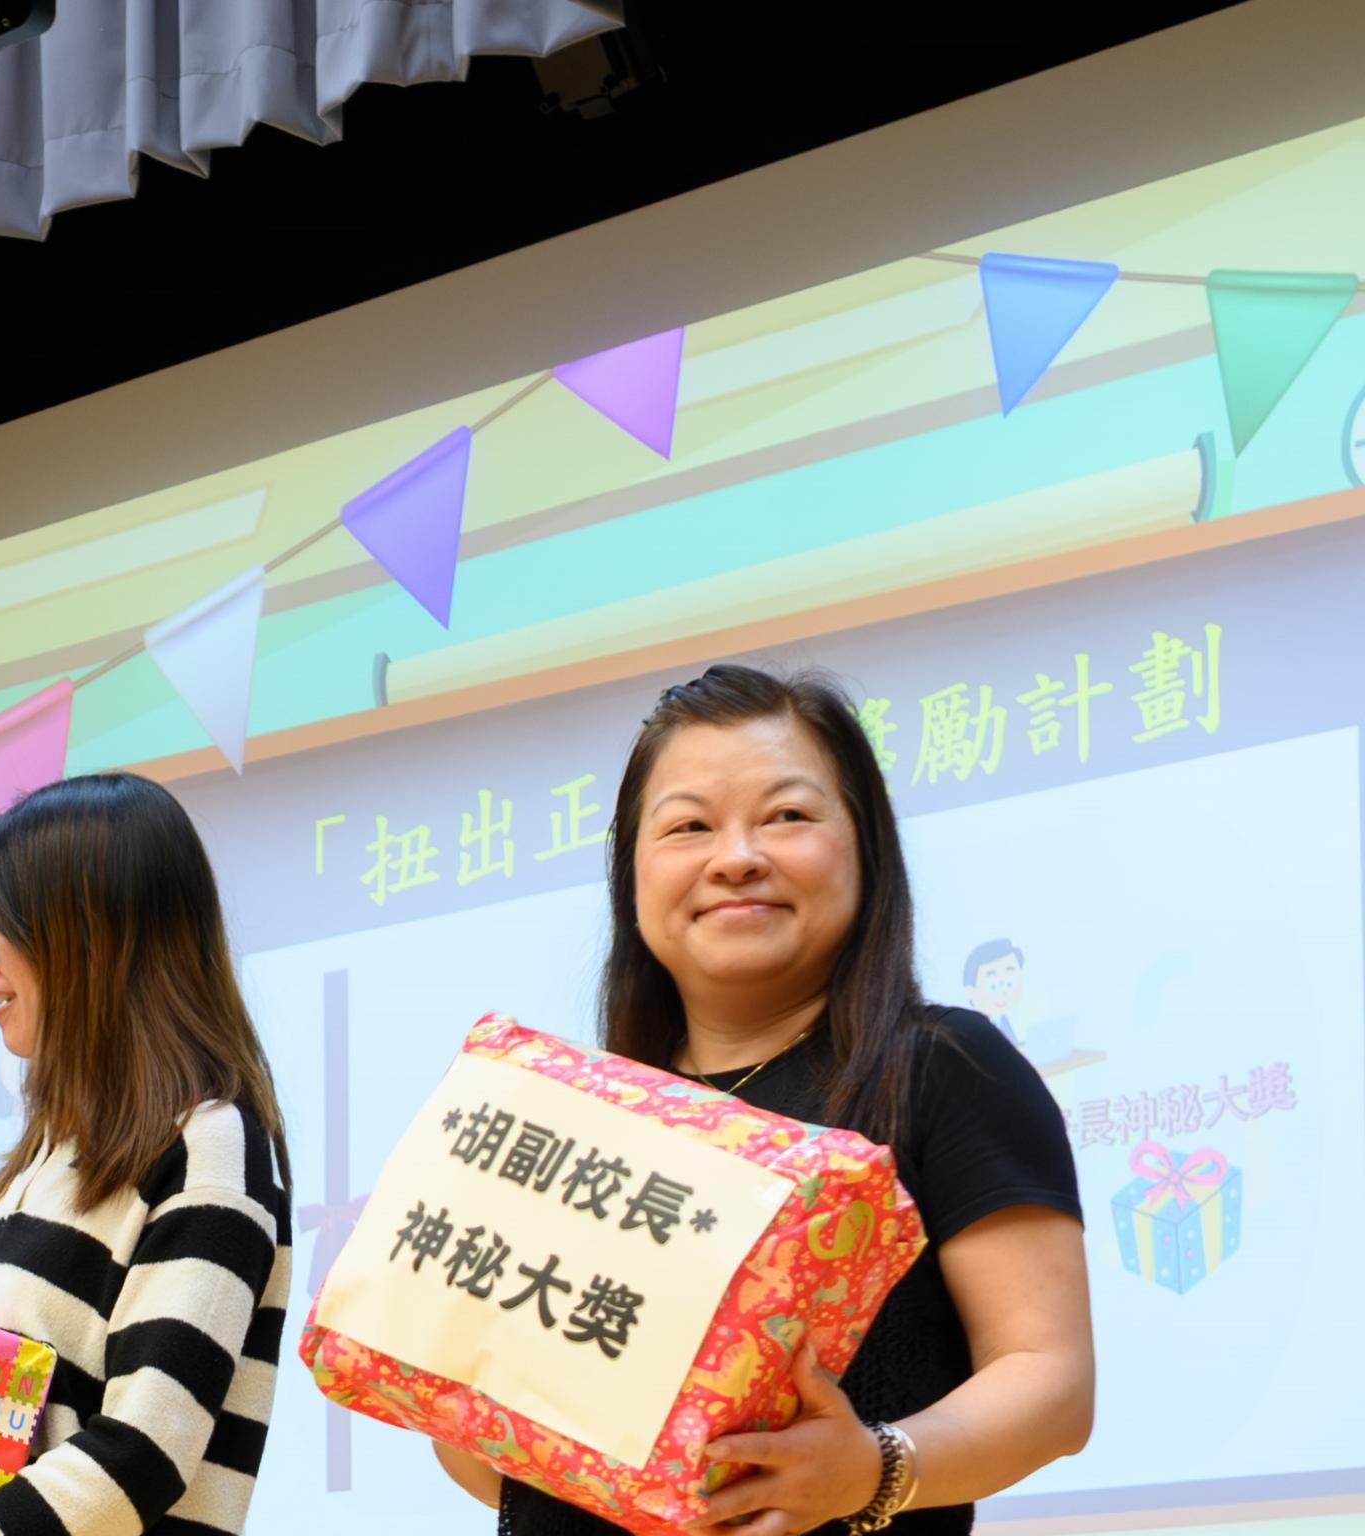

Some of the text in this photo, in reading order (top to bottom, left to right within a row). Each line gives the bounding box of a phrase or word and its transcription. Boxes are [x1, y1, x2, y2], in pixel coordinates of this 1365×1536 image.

[1064, 1061, 1298, 1151] 長神秘大獎
[389, 1200, 645, 1360] 神秘大獎
